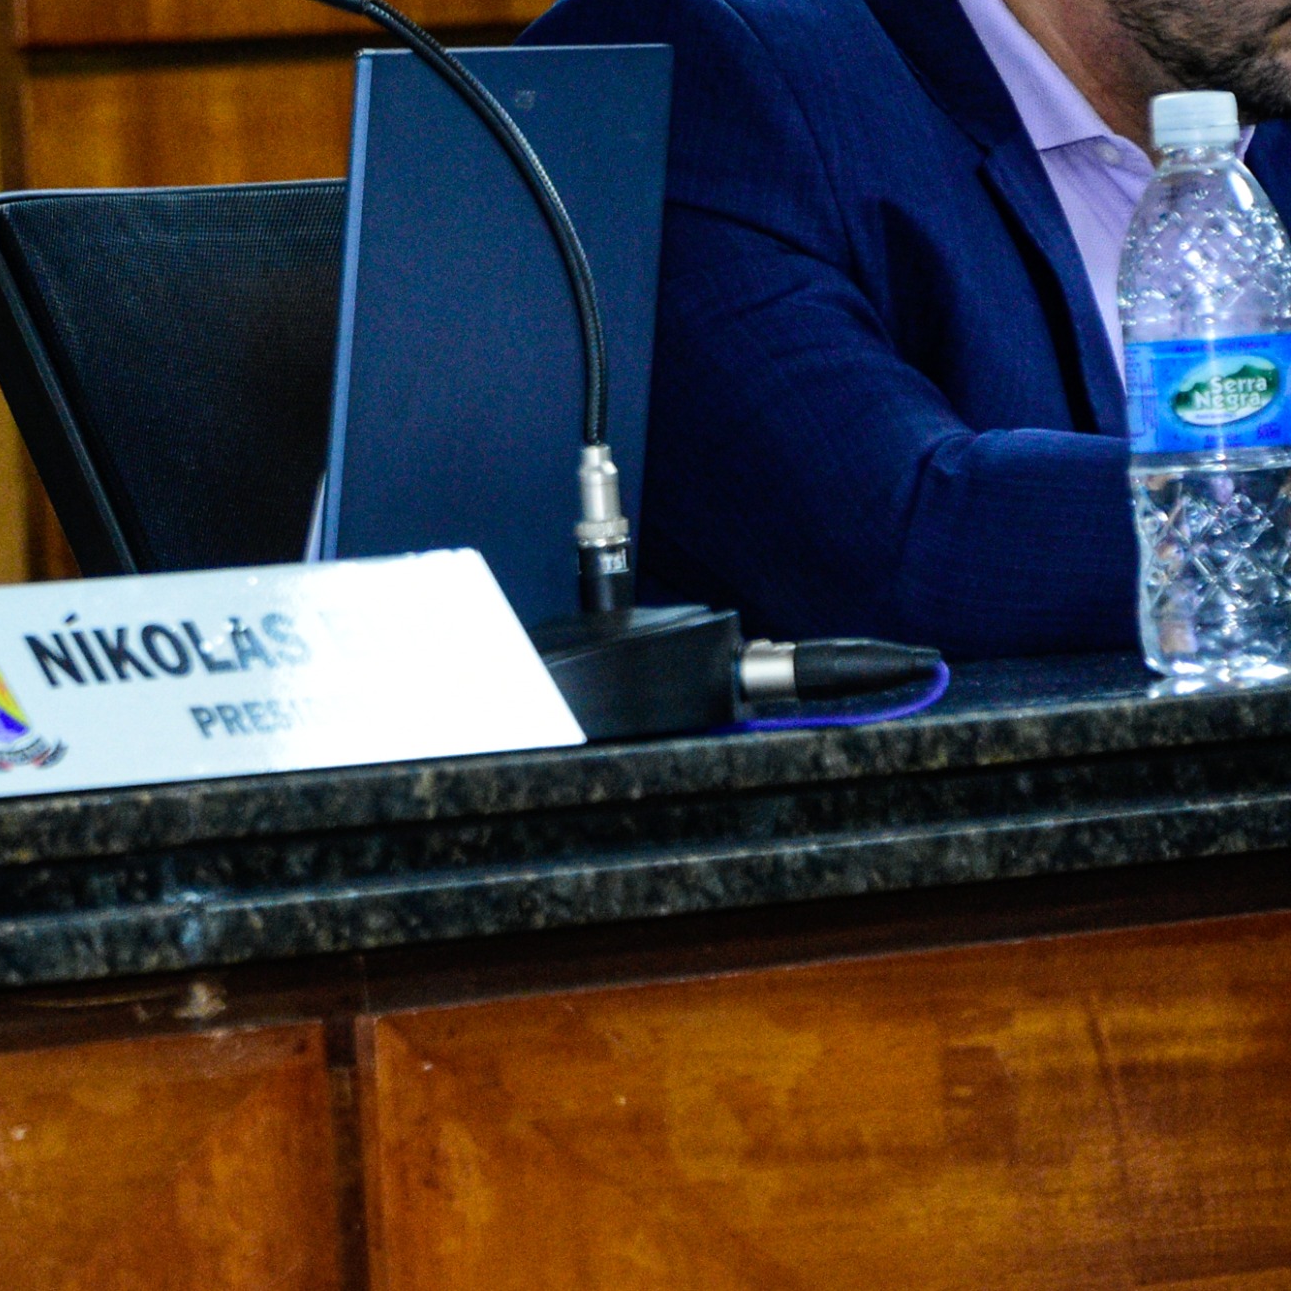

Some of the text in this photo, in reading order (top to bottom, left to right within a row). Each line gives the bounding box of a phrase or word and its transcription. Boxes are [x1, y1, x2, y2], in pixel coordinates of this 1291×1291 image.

[1209, 375, 1267, 395] Serra
[1193, 390, 1261, 413] Negra
[23, 611, 312, 688] NÍKOLAS
